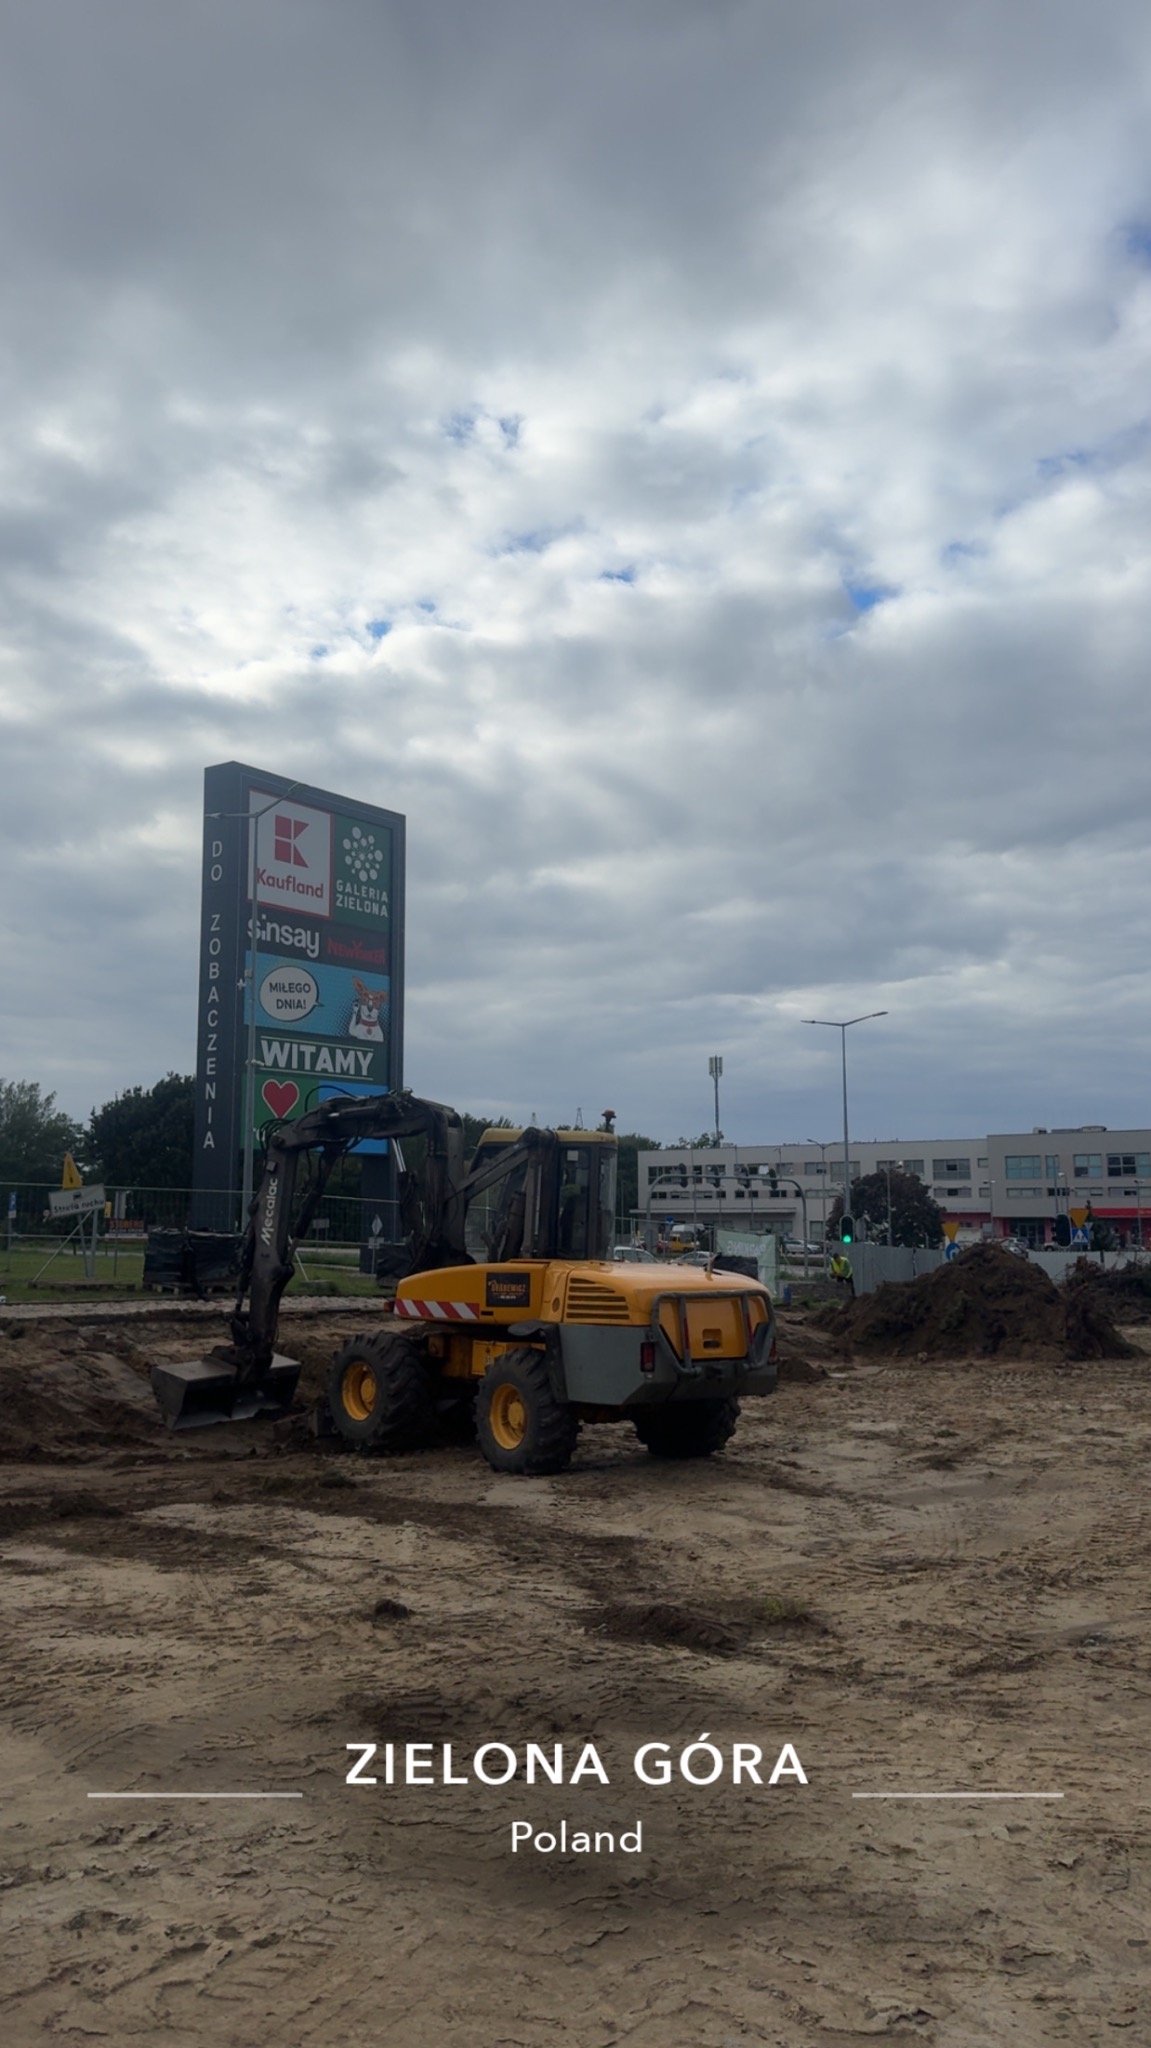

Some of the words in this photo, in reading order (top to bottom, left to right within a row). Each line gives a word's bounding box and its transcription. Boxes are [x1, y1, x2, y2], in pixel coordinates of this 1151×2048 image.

[257, 868, 324, 898] Kaufland
[336, 880, 389, 903] GALERIA
[336, 894, 389, 918] ZIELONA
[268, 982, 311, 994] MIŁEGO
[276, 998, 307, 1010] DNIA!
[203, 914, 222, 1149] ZOBACZENIA
[261, 1039, 374, 1076] WITAMY
[261, 1178, 278, 1246] Mecalac
